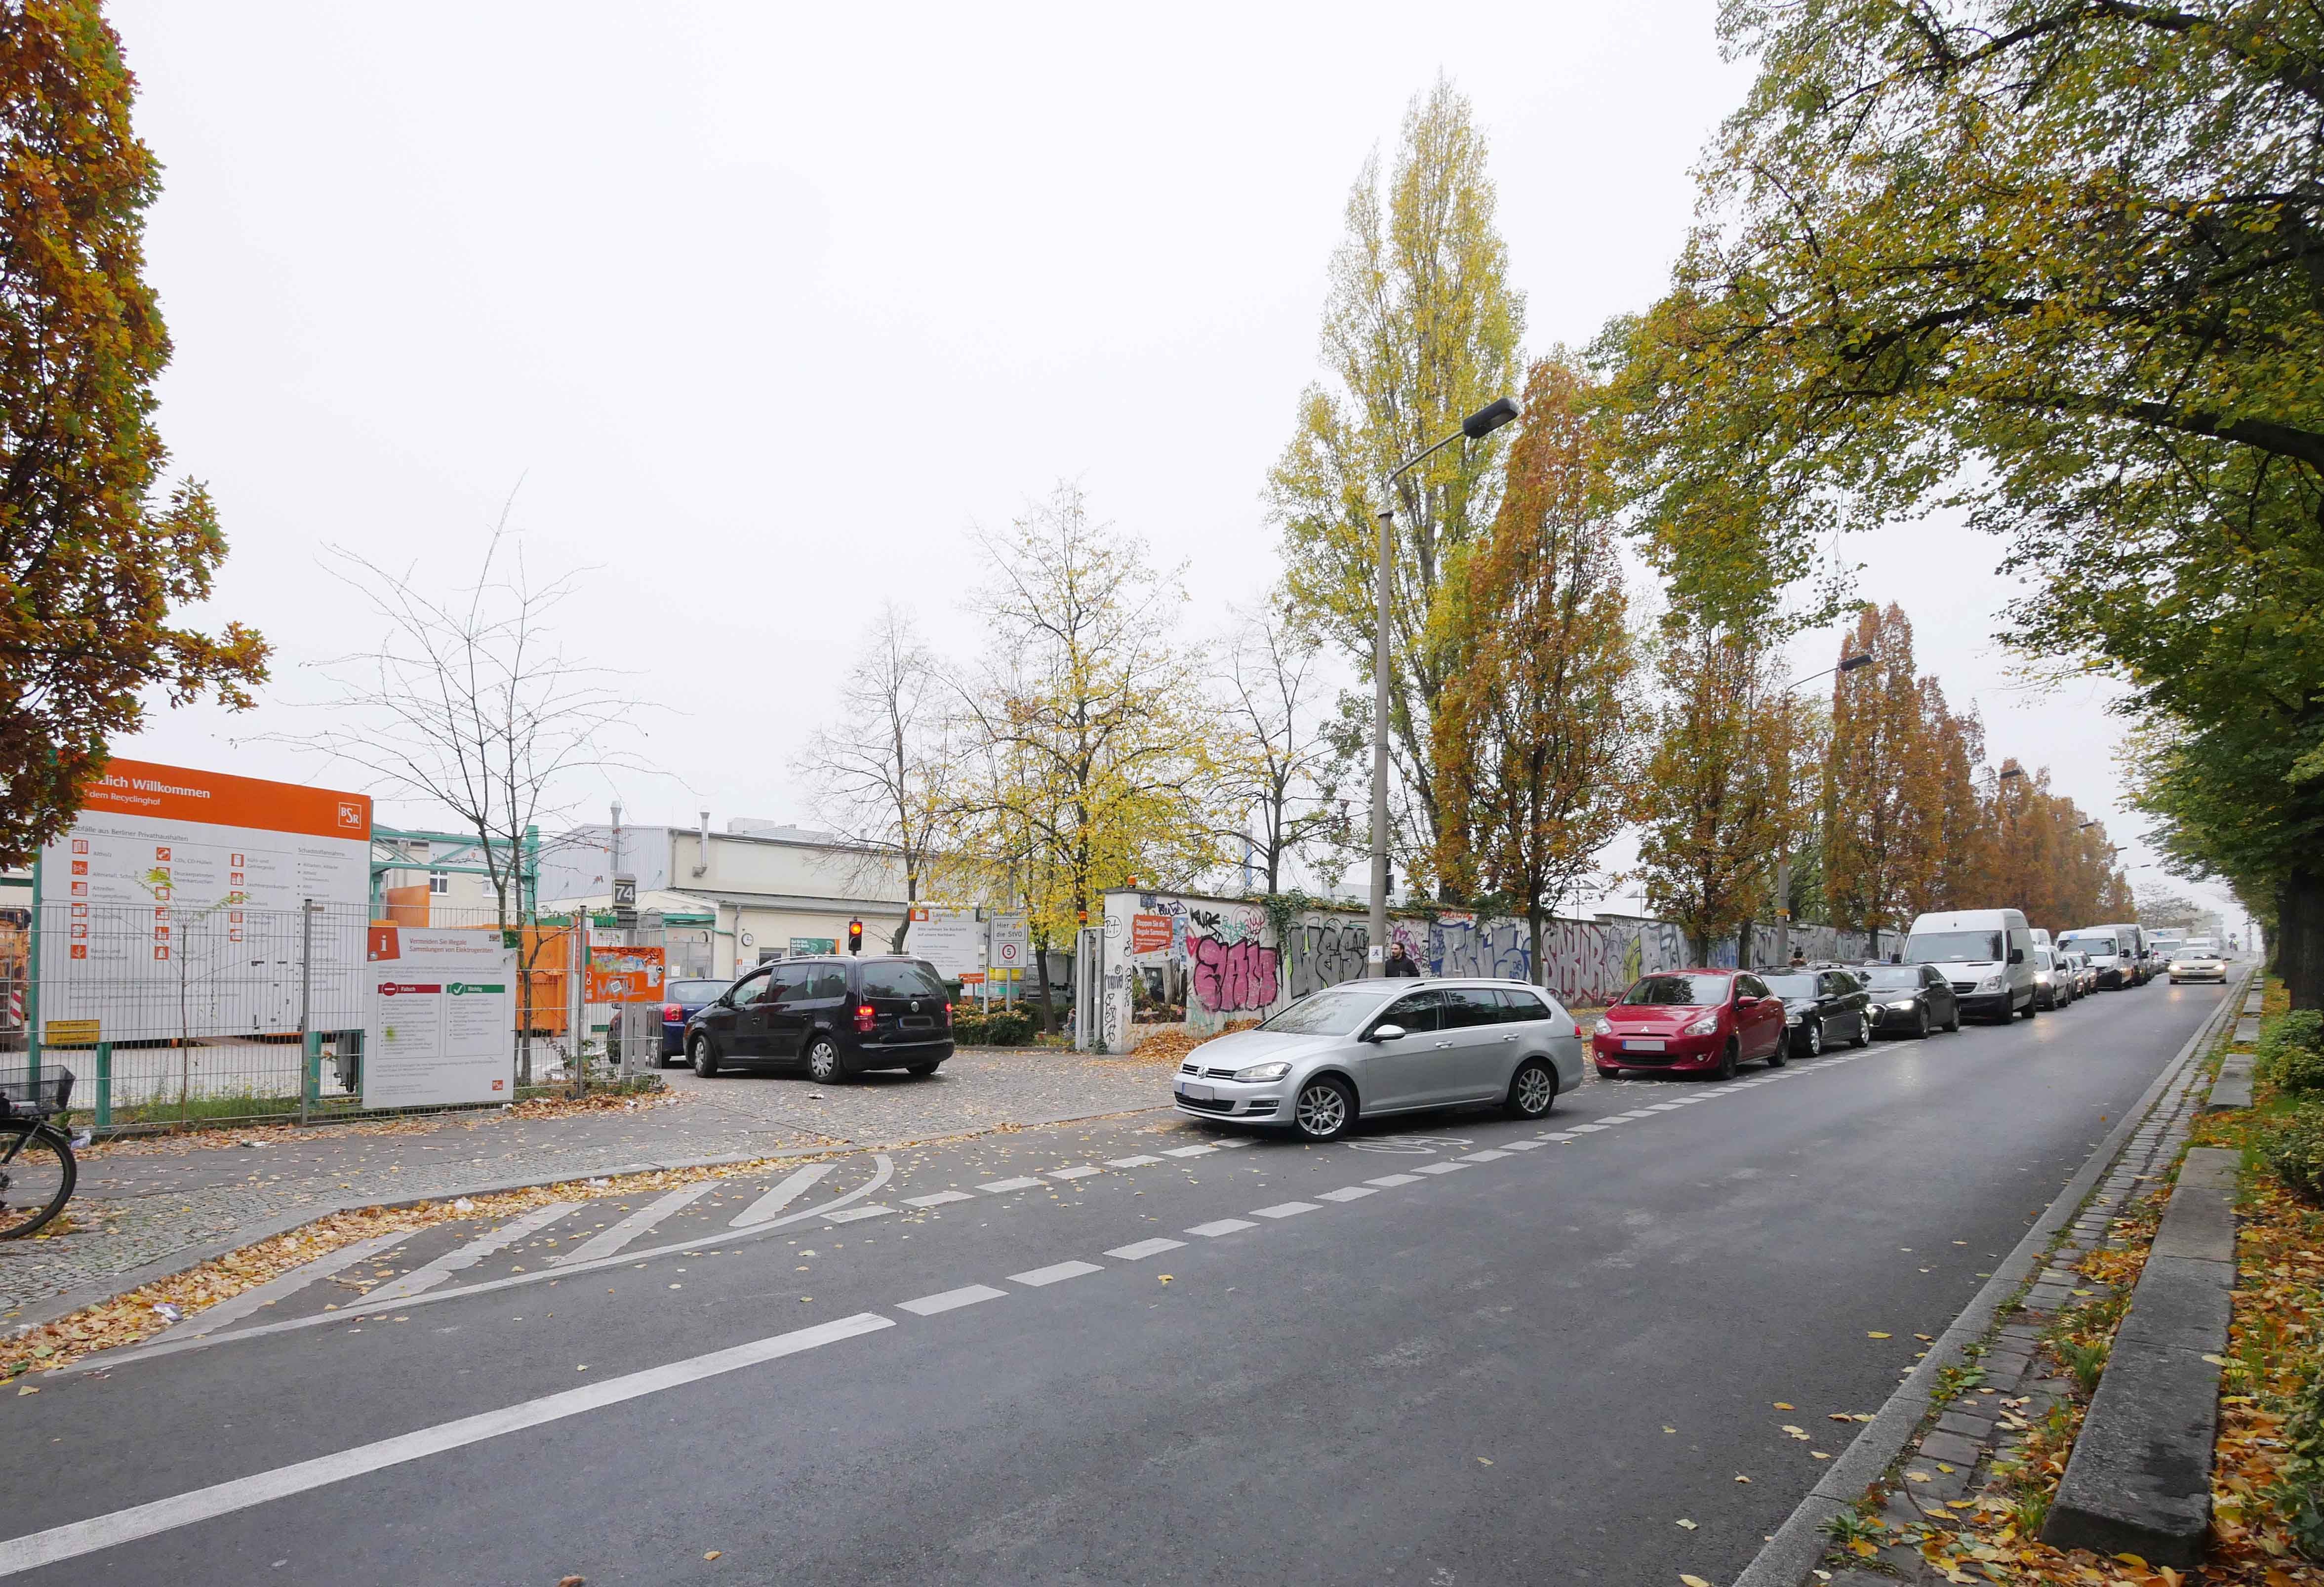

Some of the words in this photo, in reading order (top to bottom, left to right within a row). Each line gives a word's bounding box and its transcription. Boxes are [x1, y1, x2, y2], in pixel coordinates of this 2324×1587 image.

[88, 773, 128, 788] zlich
[132, 777, 211, 799] Willkommen
[89, 791, 108, 800] dem
[111, 792, 161, 806] Recyclinghof
[341, 806, 360, 824] BSR
[111, 828, 136, 837] Berliner
[138, 831, 189, 842] Privathaushalten
[615, 885, 635, 901] 74
